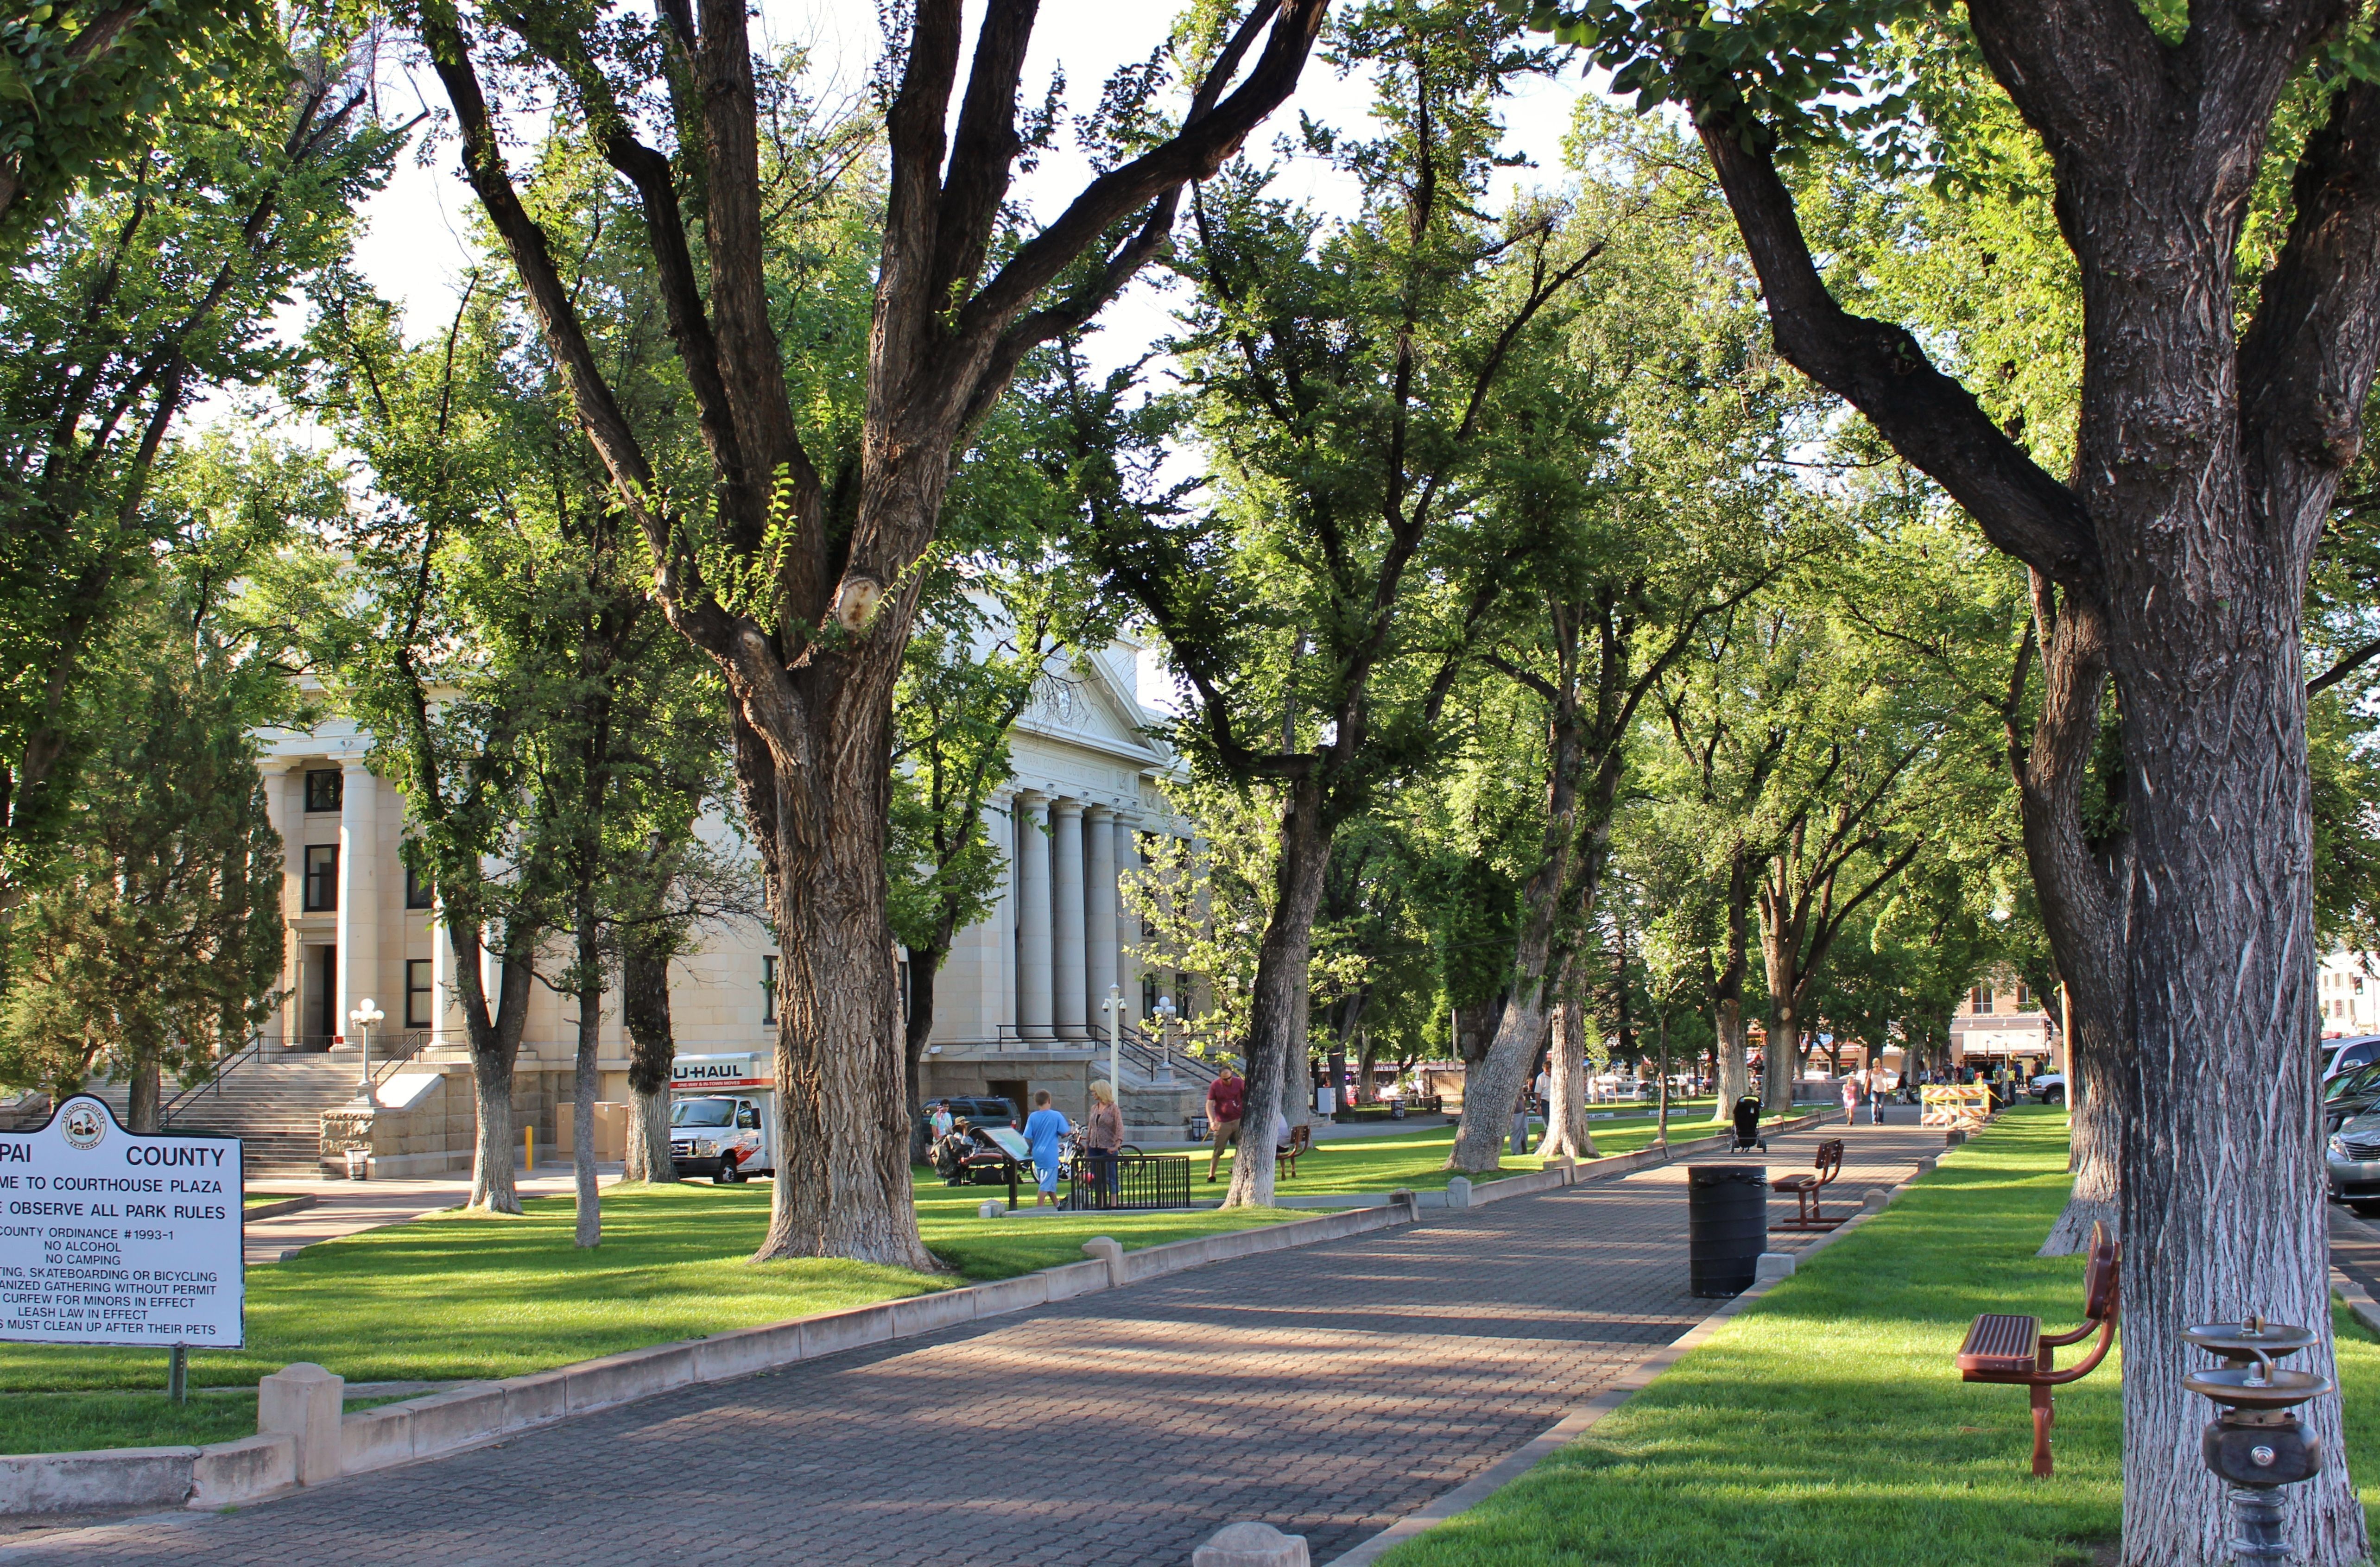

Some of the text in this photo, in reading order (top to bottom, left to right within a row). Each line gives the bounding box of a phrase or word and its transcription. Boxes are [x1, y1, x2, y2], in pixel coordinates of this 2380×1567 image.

[1020, 752, 1041, 768] YAVAPAI
[1044, 758, 1067, 773] COUNTY
[1069, 765, 1086, 778] COURT
[62, 1104, 105, 1124] YAVAPAI COUNTY
[127, 1146, 225, 1167] COUNTY
[26, 1176, 46, 1189] TO
[54, 1177, 163, 1192] COURTHOUSE
[171, 1180, 222, 1193] PLAZA
[10, 1201, 83, 1216] OBSERVE
[91, 1204, 119, 1217] ALL
[127, 1205, 166, 1218] PARK
[174, 1206, 225, 1219] RULES
[49, 1227, 118, 1238] ORDINANCE
[124, 1230, 173, 1240] #1993-1
[44, 1241, 121, 1252] NO ALCOHOL
[46, 1254, 120, 1265] NO CAMPING
[30, 1268, 129, 1280] SKATEBOARDING
[133, 1270, 150, 1280] OR
[154, 1271, 217, 1282] BICYCLING
[44, 1281, 111, 1292] GATHERING
[115, 1283, 169, 1294] WITHOUT
[173, 1285, 216, 1295] PERMIT
[3, 1293, 195, 1308] CURFEW FOR MINORS IN EFFECT
[19, 1307, 148, 1320] LEASH LAW IN EFFECT
[8, 1320, 40, 1330] MUST
[44, 1321, 82, 1331] CLEAN
[87, 1322, 101, 1332] UP
[105, 1323, 143, 1333] AFTER
[148, 1324, 182, 1333] THEIR
[186, 1325, 216, 1335] PETS
